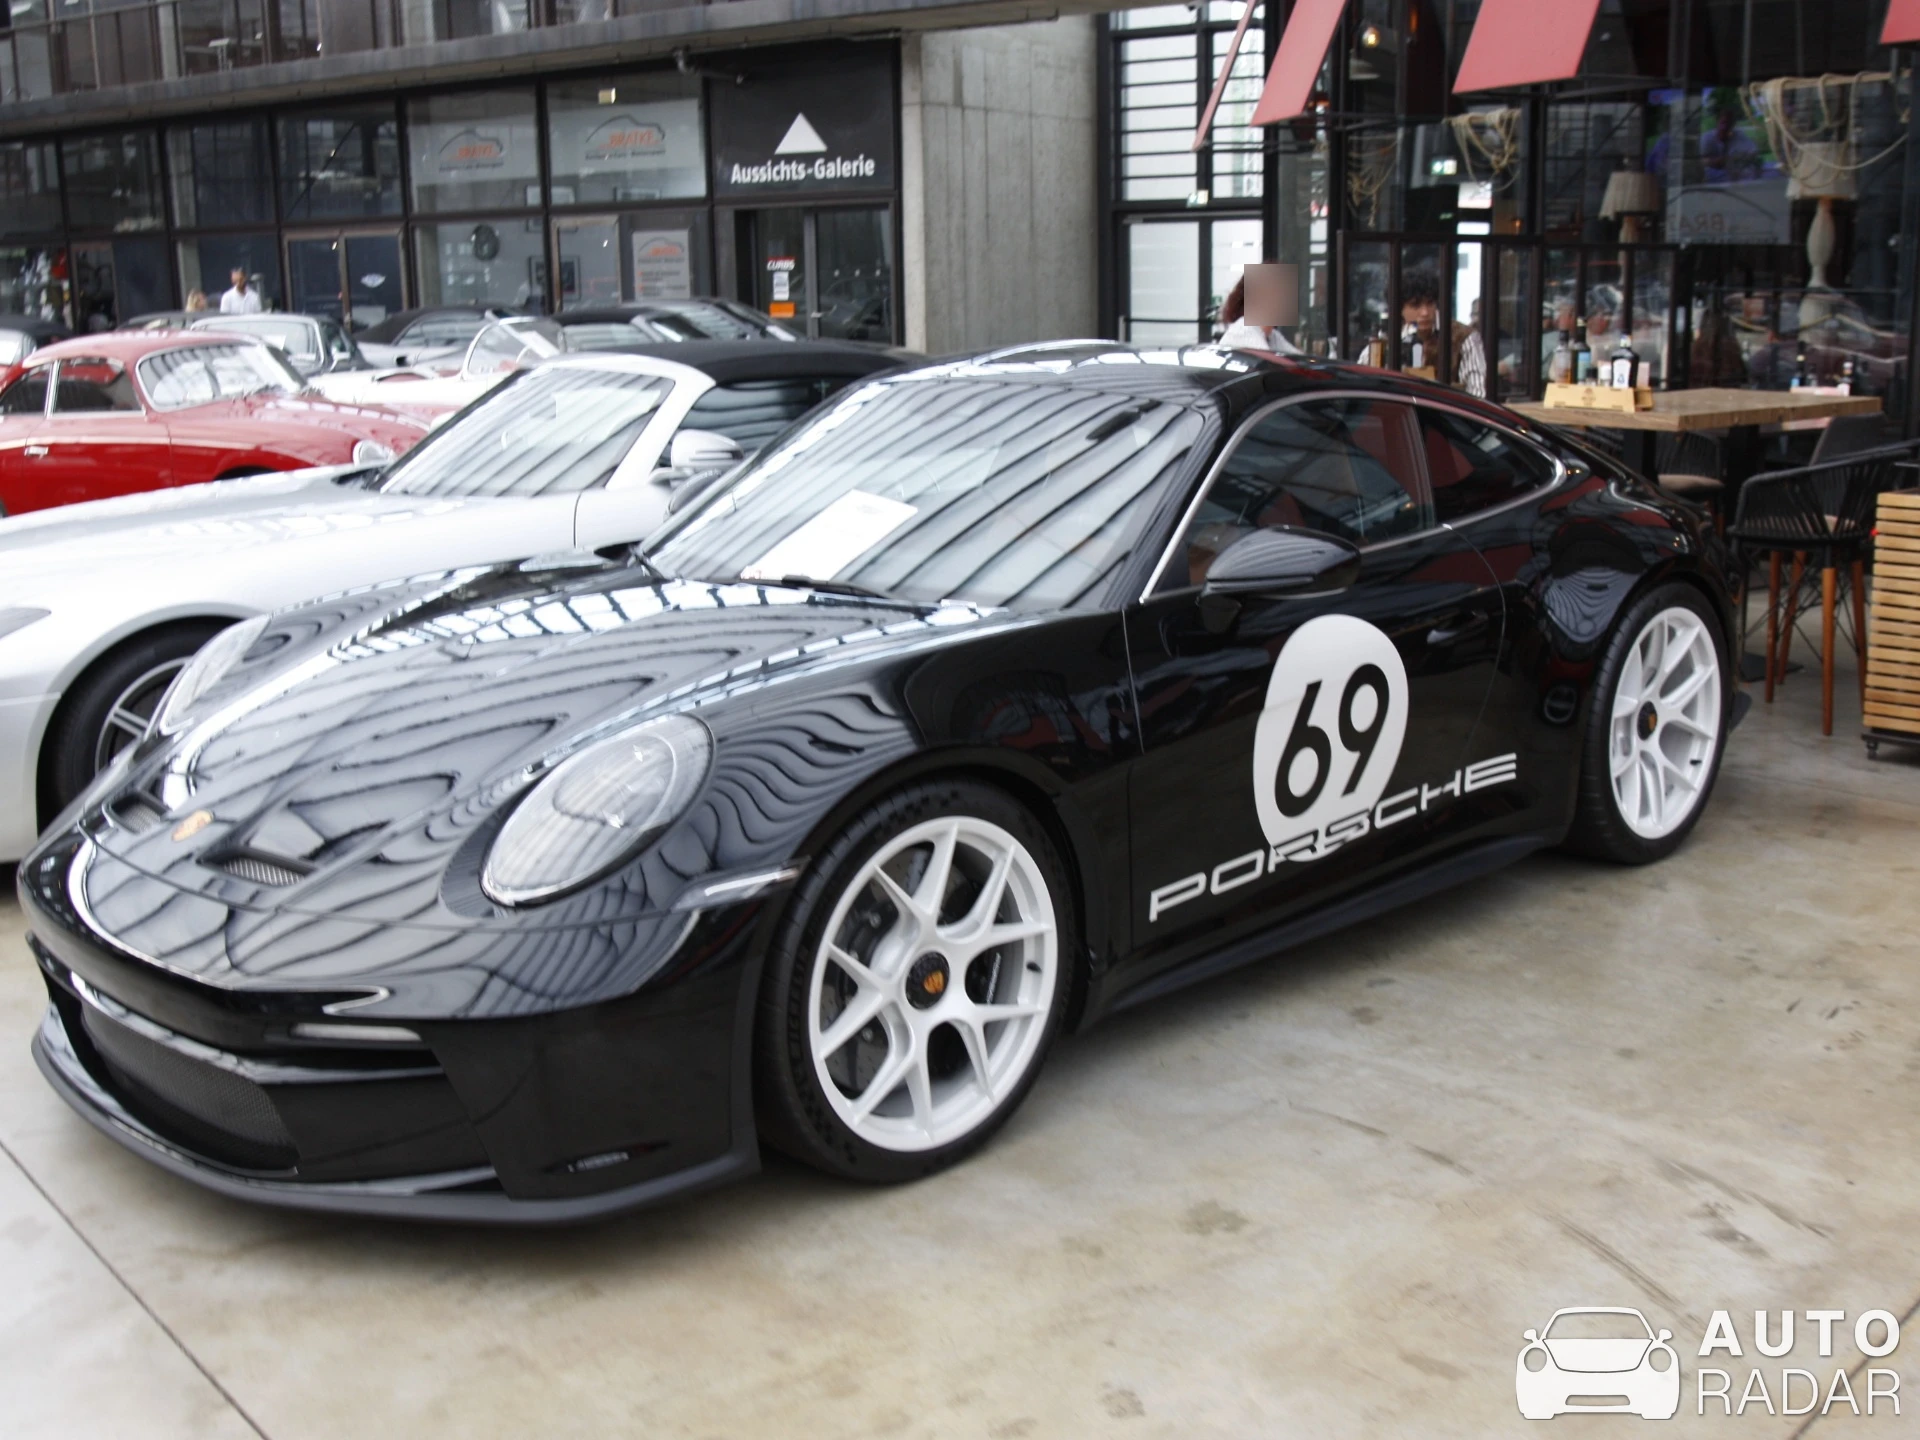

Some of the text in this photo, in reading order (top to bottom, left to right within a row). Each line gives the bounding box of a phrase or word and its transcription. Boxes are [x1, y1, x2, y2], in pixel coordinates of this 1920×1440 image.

[730, 153, 875, 184] Aussichts-Galerie
[1275, 663, 1390, 820] 69
[1149, 753, 1517, 922] PORSCHE
